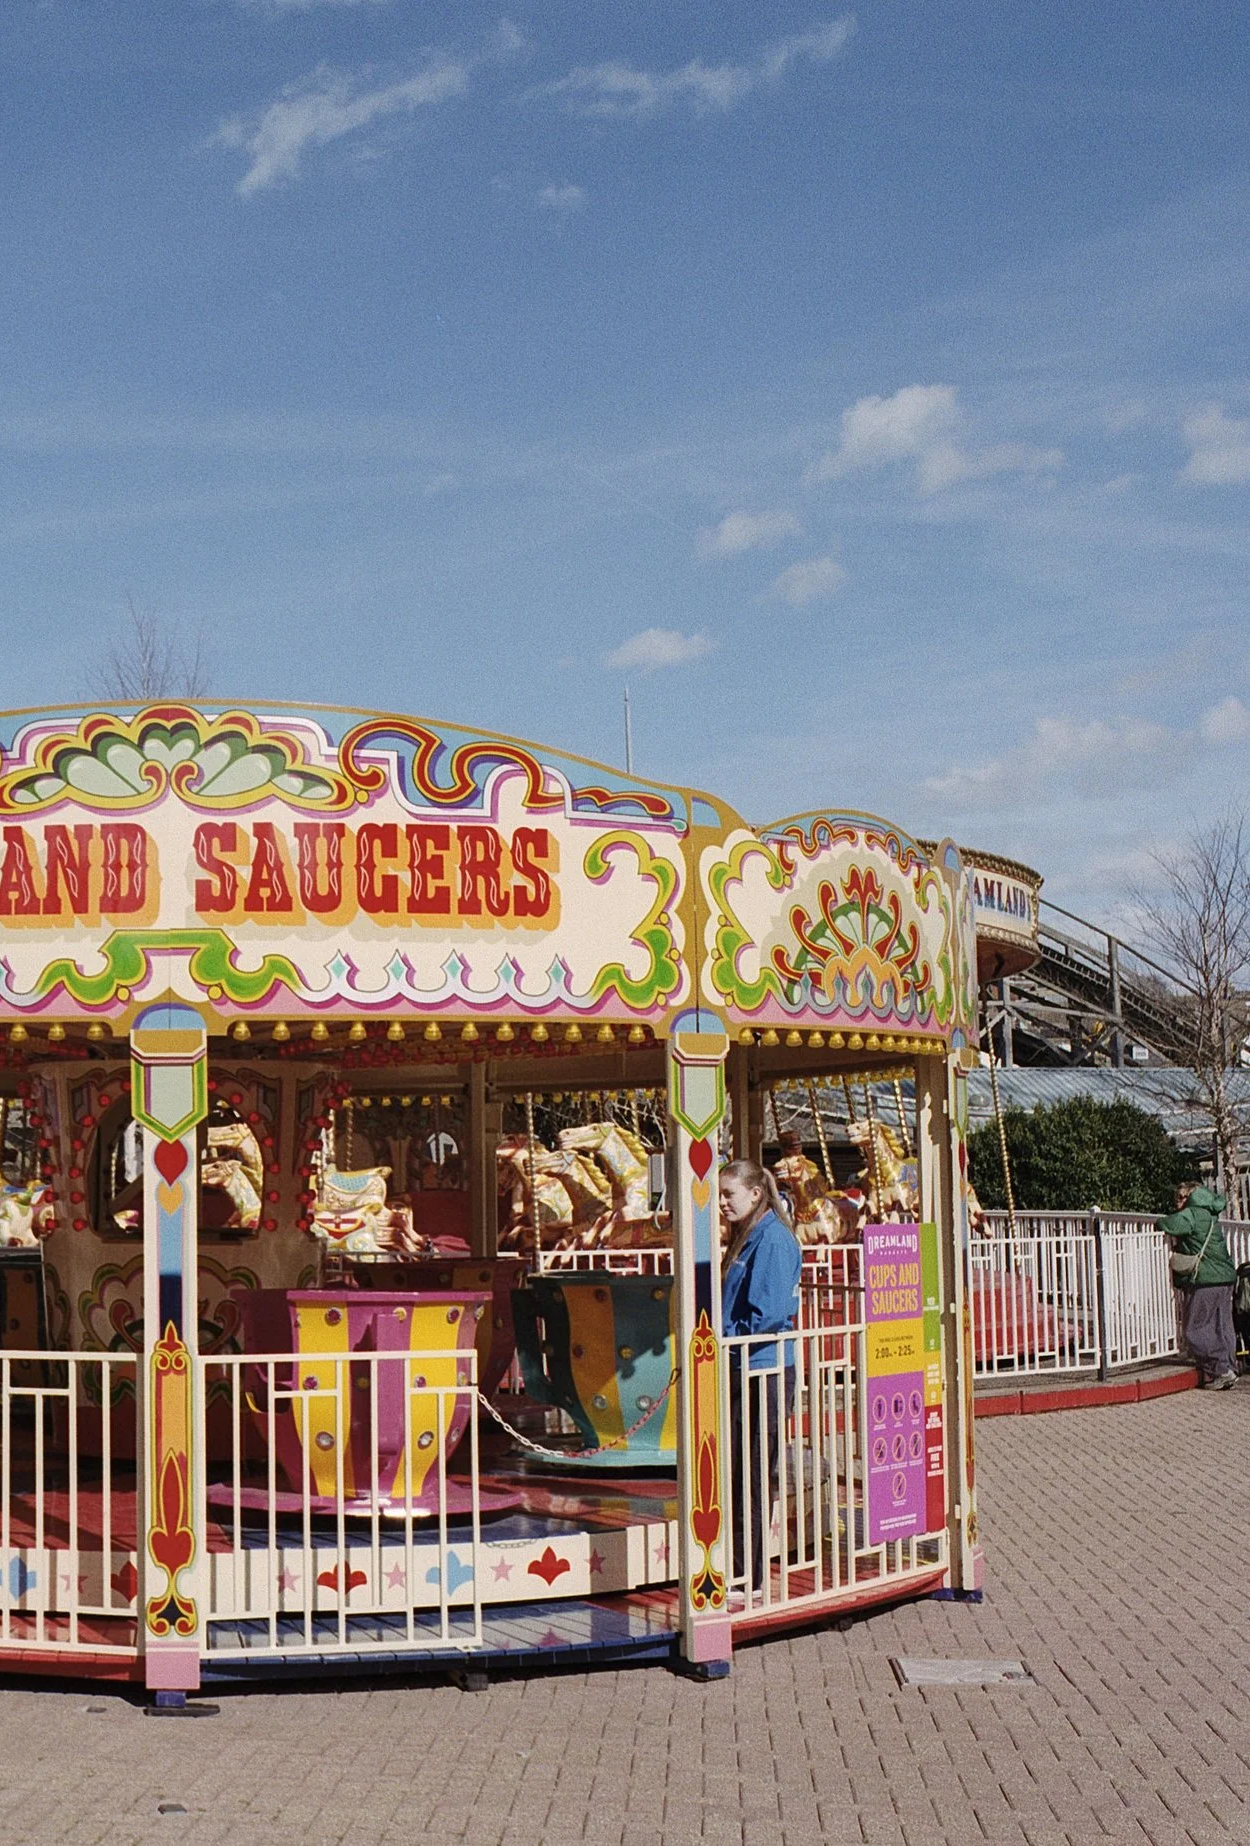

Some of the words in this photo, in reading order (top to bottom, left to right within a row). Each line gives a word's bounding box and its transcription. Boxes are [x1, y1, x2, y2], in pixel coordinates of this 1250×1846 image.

[193, 821, 560, 931] SAUCERS
[868, 1234, 918, 1254] DREAMLAND
[870, 1264, 896, 1288] CUPS
[898, 1263, 920, 1286] AND
[872, 1288, 918, 1315] SAUCERS
